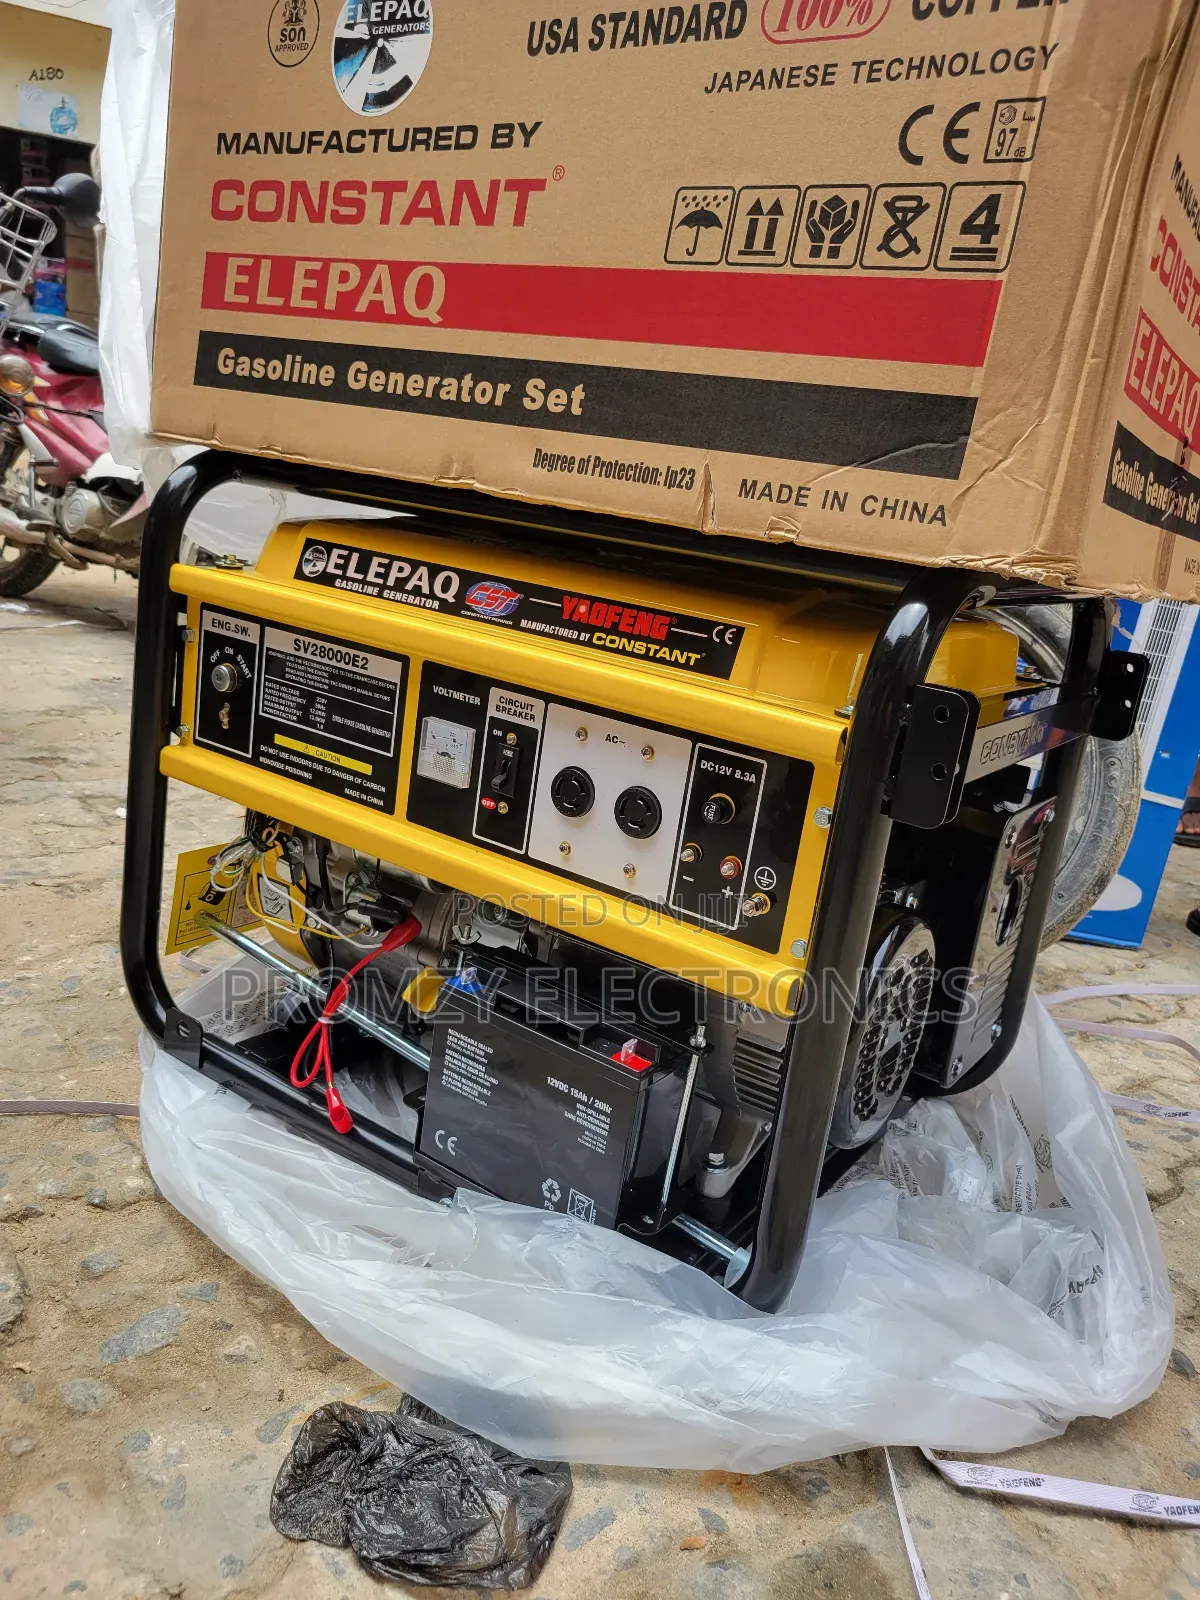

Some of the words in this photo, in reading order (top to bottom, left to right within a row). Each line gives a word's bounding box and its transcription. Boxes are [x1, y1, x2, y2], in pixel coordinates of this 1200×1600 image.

[373, 21, 431, 35] GENERATORS
[527, 16, 579, 56] USA
[588, 0, 748, 51] STANDARD
[275, 43, 309, 53] APPROVED
[704, 63, 839, 94] JAPANESE
[851, 43, 1059, 84] TECHNOLOGY
[216, 124, 479, 155] MANUFACTURED
[490, 121, 543, 149] BY
[995, 128, 1018, 157] 97
[1014, 147, 1026, 157] dB
[223, 257, 446, 323] ELEPAQ
[216, 347, 336, 387] Gasoline
[347, 361, 511, 406] Generator
[522, 378, 586, 416] Set
[533, 448, 576, 475] Degree
[577, 455, 590, 475] of
[591, 457, 663, 486] Protection:
[1112, 448, 1144, 500] Gasoline
[738, 478, 811, 507] MADE
[821, 489, 849, 513] IN
[860, 496, 947, 526] CHINA
[325, 548, 460, 602] ELEPAQ
[335, 579, 379, 596] GASOLINE
[383, 589, 439, 610] GENERATOR
[211, 618, 251, 637] ENG.SW.
[520, 619, 578, 639] MANUFACTURED
[580, 632, 590, 641] BY
[210, 649, 220, 662] OFF
[225, 646, 233, 655] ON
[236, 654, 252, 678] START
[293, 638, 369, 670] SV28000E2
[433, 685, 481, 706] VOLTMETER
[499, 695, 534, 712] CIRCUIT
[495, 704, 536, 722] BREAKER
[493, 729, 502, 737] ON
[259, 756, 285, 770] MONOXIDE
[285, 765, 312, 779] POISONING
[316, 750, 340, 763] CAUTION
[268, 747, 279, 756] NOT
[279, 751, 289, 759] USE
[290, 754, 312, 767] INDOORS
[313, 762, 323, 772] DUE
[324, 765, 331, 773] TO
[332, 769, 354, 782] DANGER
[363, 780, 386, 793] CARBON
[701, 759, 732, 776] DC12V
[735, 770, 756, 783] 8.3A
[345, 787, 360, 798] MADE
[361, 792, 366, 800] IN
[367, 795, 383, 806] CHINA
[482, 799, 495, 807] OFF
[707, 804, 716, 821] FUSE
[547, 1076, 568, 1093] 12VDC
[570, 1087, 588, 1103] 15Ah
[594, 1099, 613, 1114] 20Hr
[544, 1200, 554, 1211] Pb
[999, 1477, 1043, 1488] YAOFENG
[1163, 1505, 1200, 1517] YAOFEN
